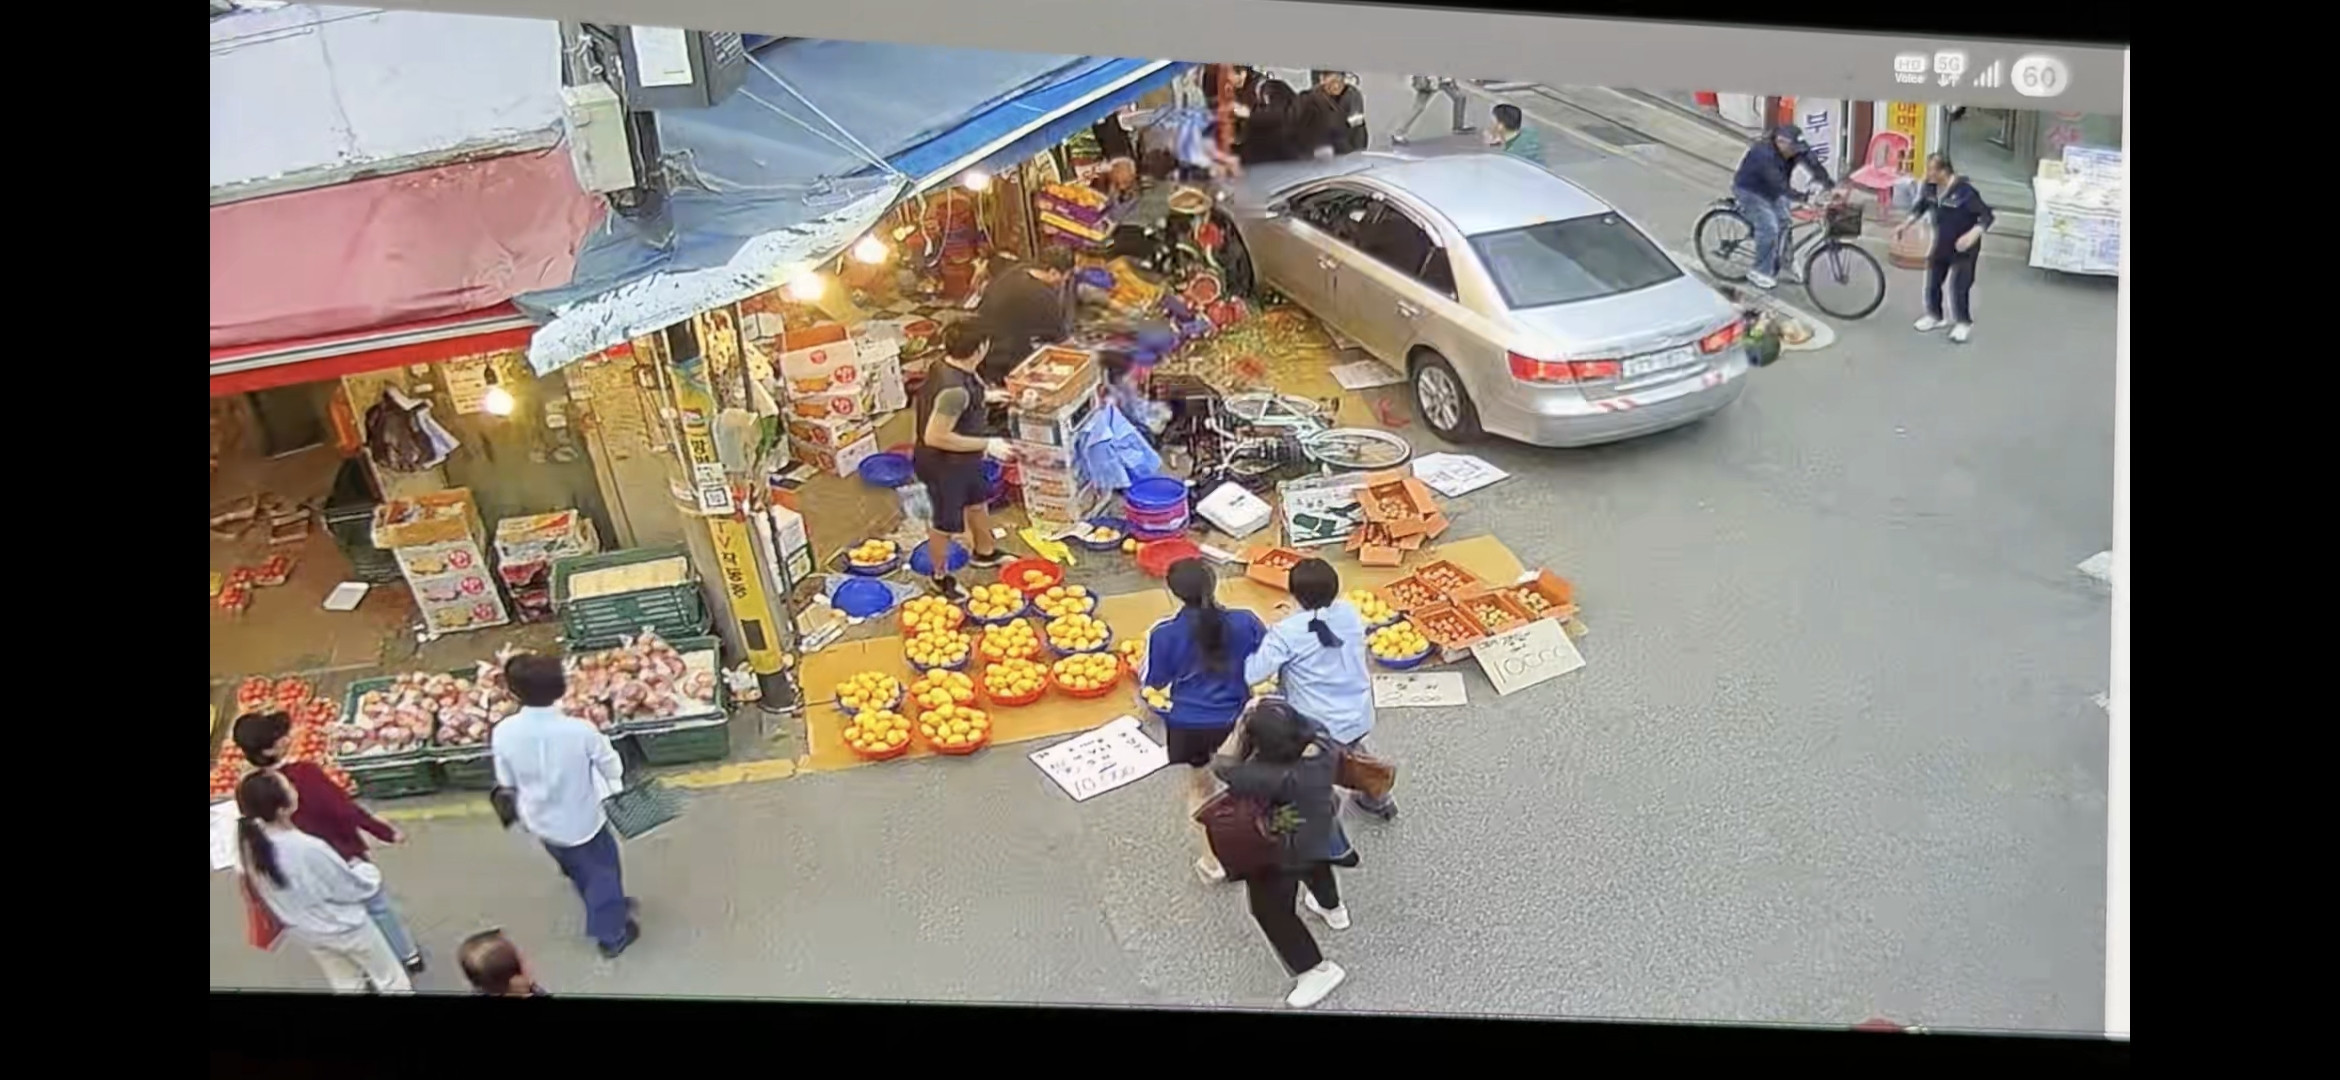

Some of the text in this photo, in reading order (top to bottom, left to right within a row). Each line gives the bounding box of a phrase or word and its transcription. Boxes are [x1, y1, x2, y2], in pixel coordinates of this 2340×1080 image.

[1939, 56, 1960, 71] 5G
[1895, 72, 1924, 84] Voice
[2022, 65, 2057, 89] 60
